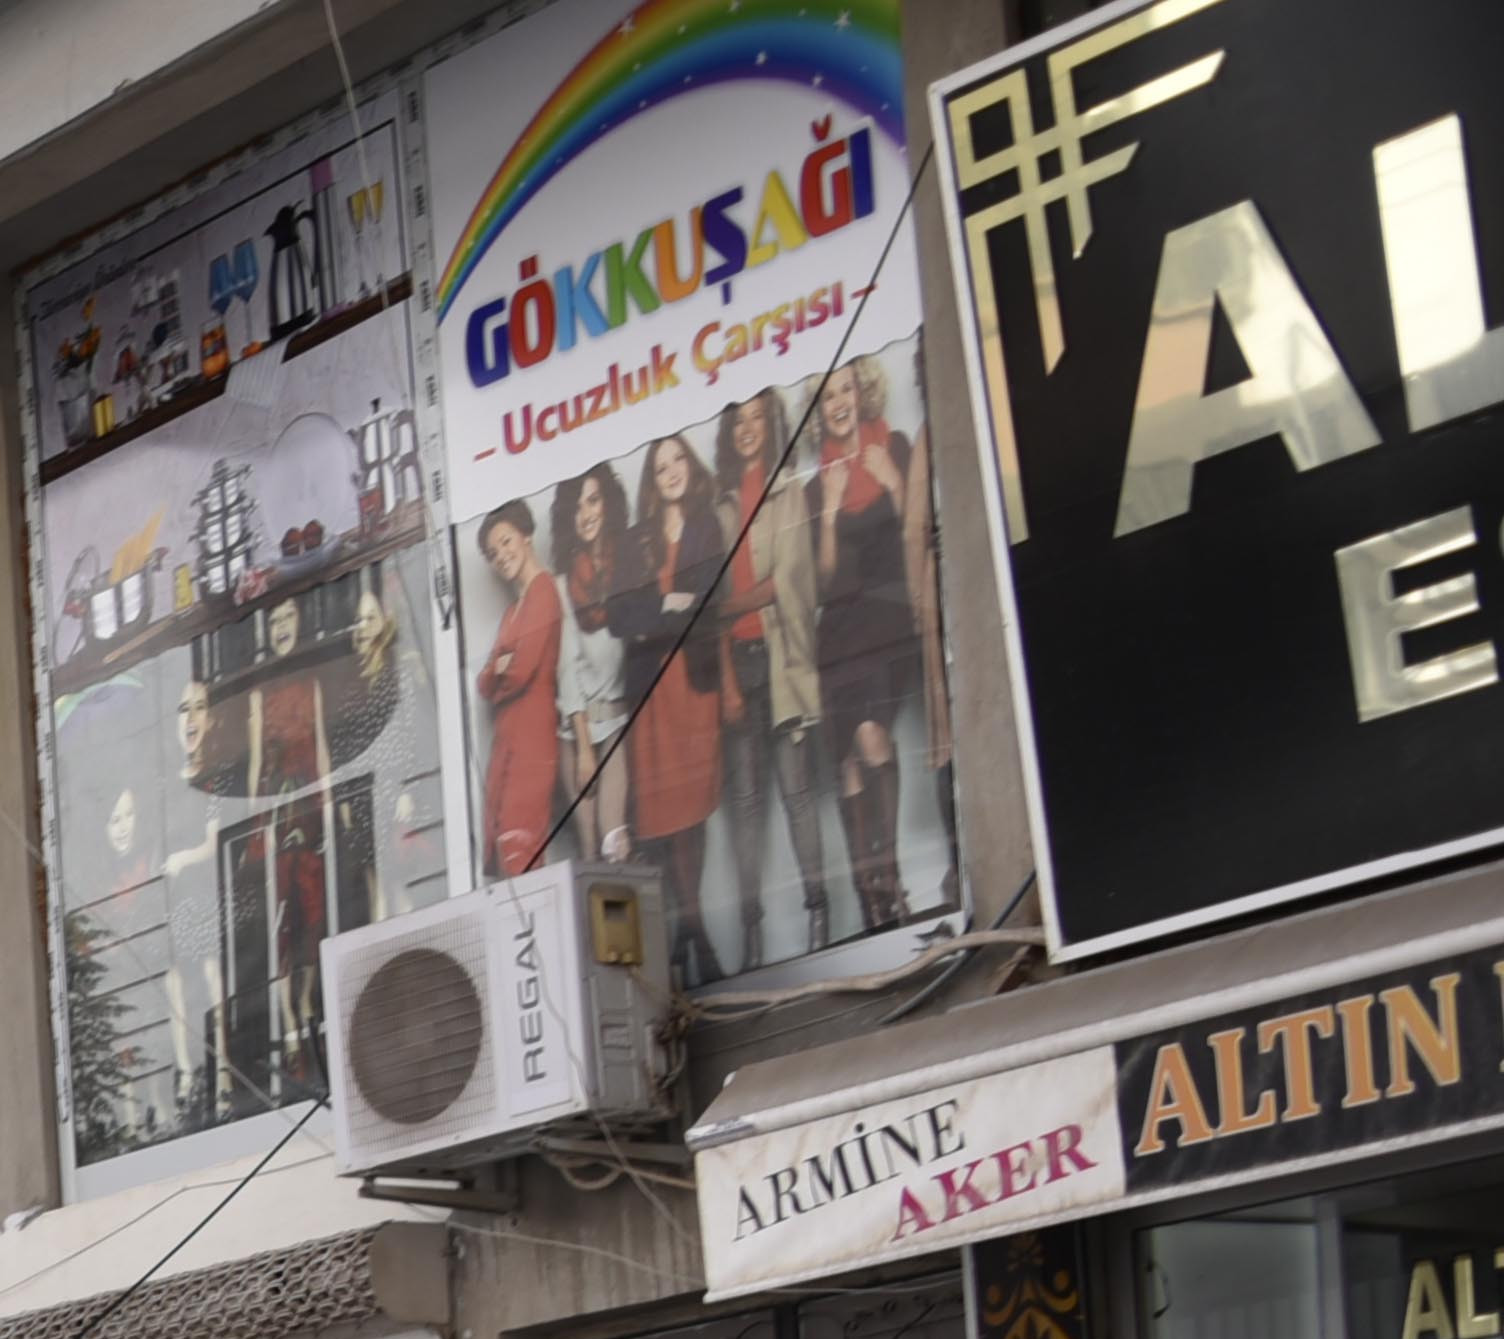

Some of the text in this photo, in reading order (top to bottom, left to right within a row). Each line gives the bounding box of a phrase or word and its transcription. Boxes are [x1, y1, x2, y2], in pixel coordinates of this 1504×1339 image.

[465, 113, 879, 389] GÖKKUŞAĞI
[501, 280, 845, 457] Ucuzluk Çarşısı
[513, 911, 547, 1083] REGAL
[1133, 973, 1462, 1158] ALTIN
[732, 1099, 966, 1242] ARMİNE
[891, 1123, 1097, 1241] AKER
